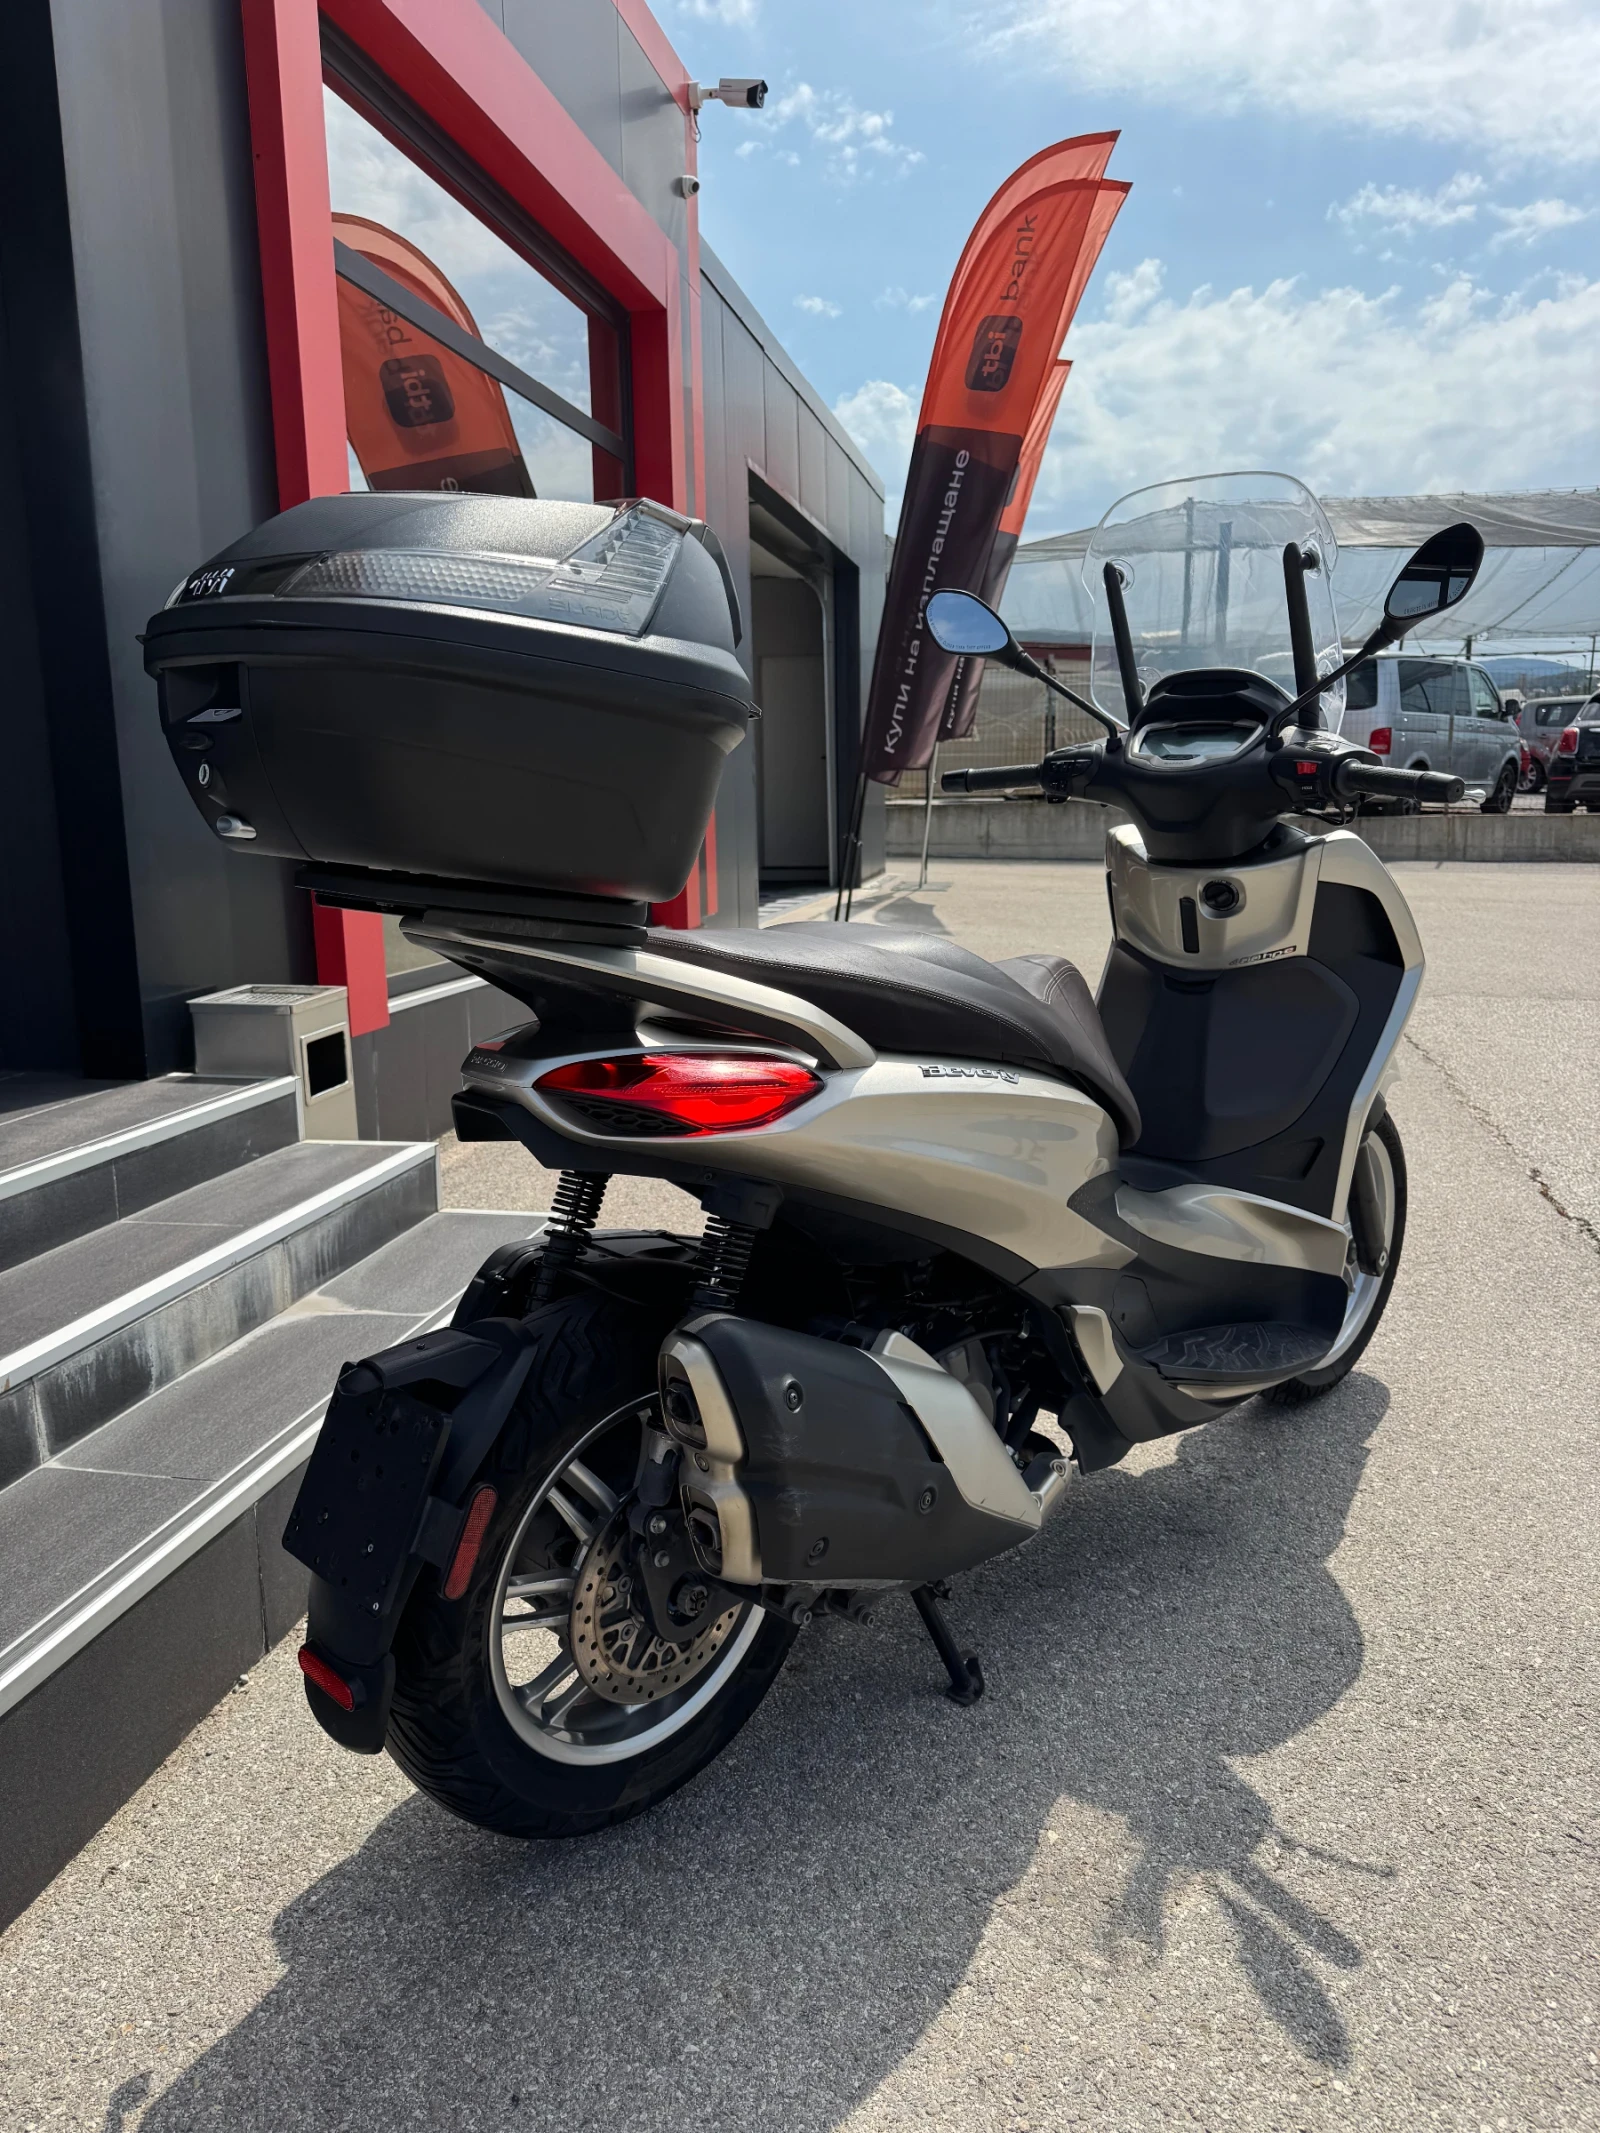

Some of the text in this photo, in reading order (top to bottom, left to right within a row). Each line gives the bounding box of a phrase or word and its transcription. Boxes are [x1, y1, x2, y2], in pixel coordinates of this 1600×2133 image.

[982, 213, 1038, 377] tbi bank
[884, 683, 911, 754] Купи
[905, 640, 920, 677] на
[915, 449, 970, 630] изплащане
[918, 1064, 1020, 1084] Beverly
